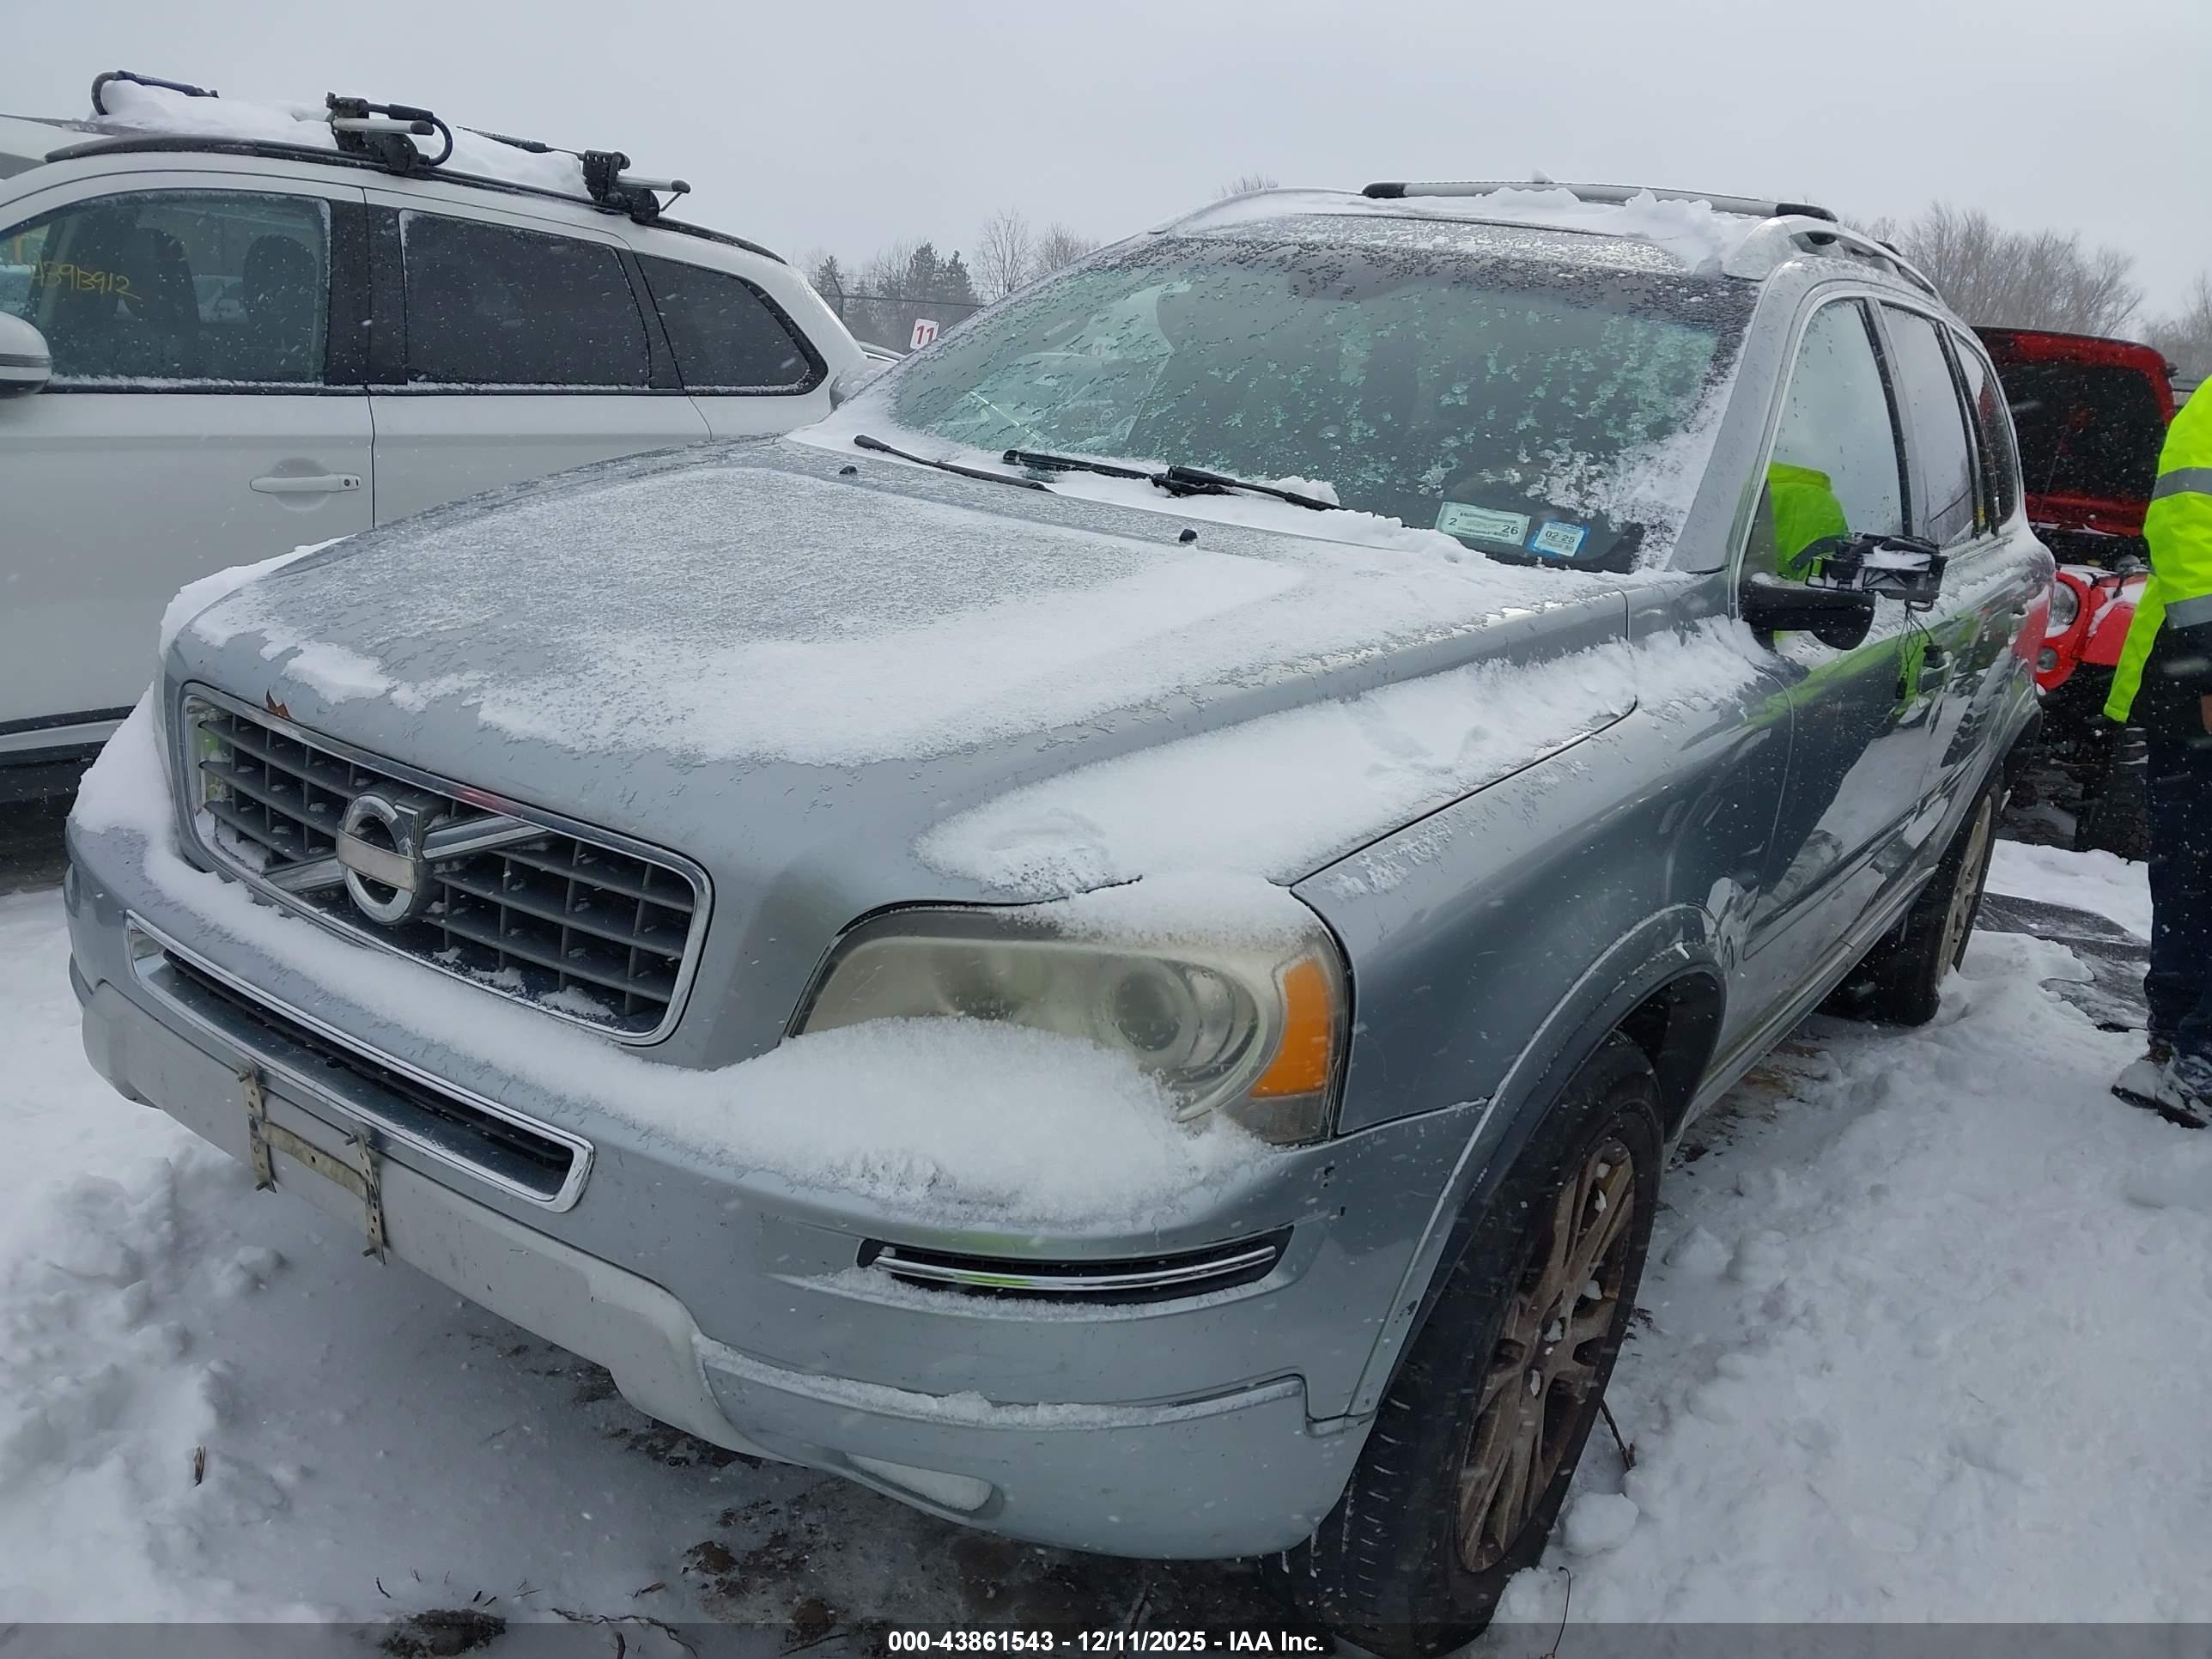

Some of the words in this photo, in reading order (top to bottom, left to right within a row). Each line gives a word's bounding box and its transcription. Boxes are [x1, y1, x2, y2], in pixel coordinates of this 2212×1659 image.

[916, 325, 935, 344] 11
[1448, 517, 1458, 526] 2
[1501, 525, 1519, 535] 26
